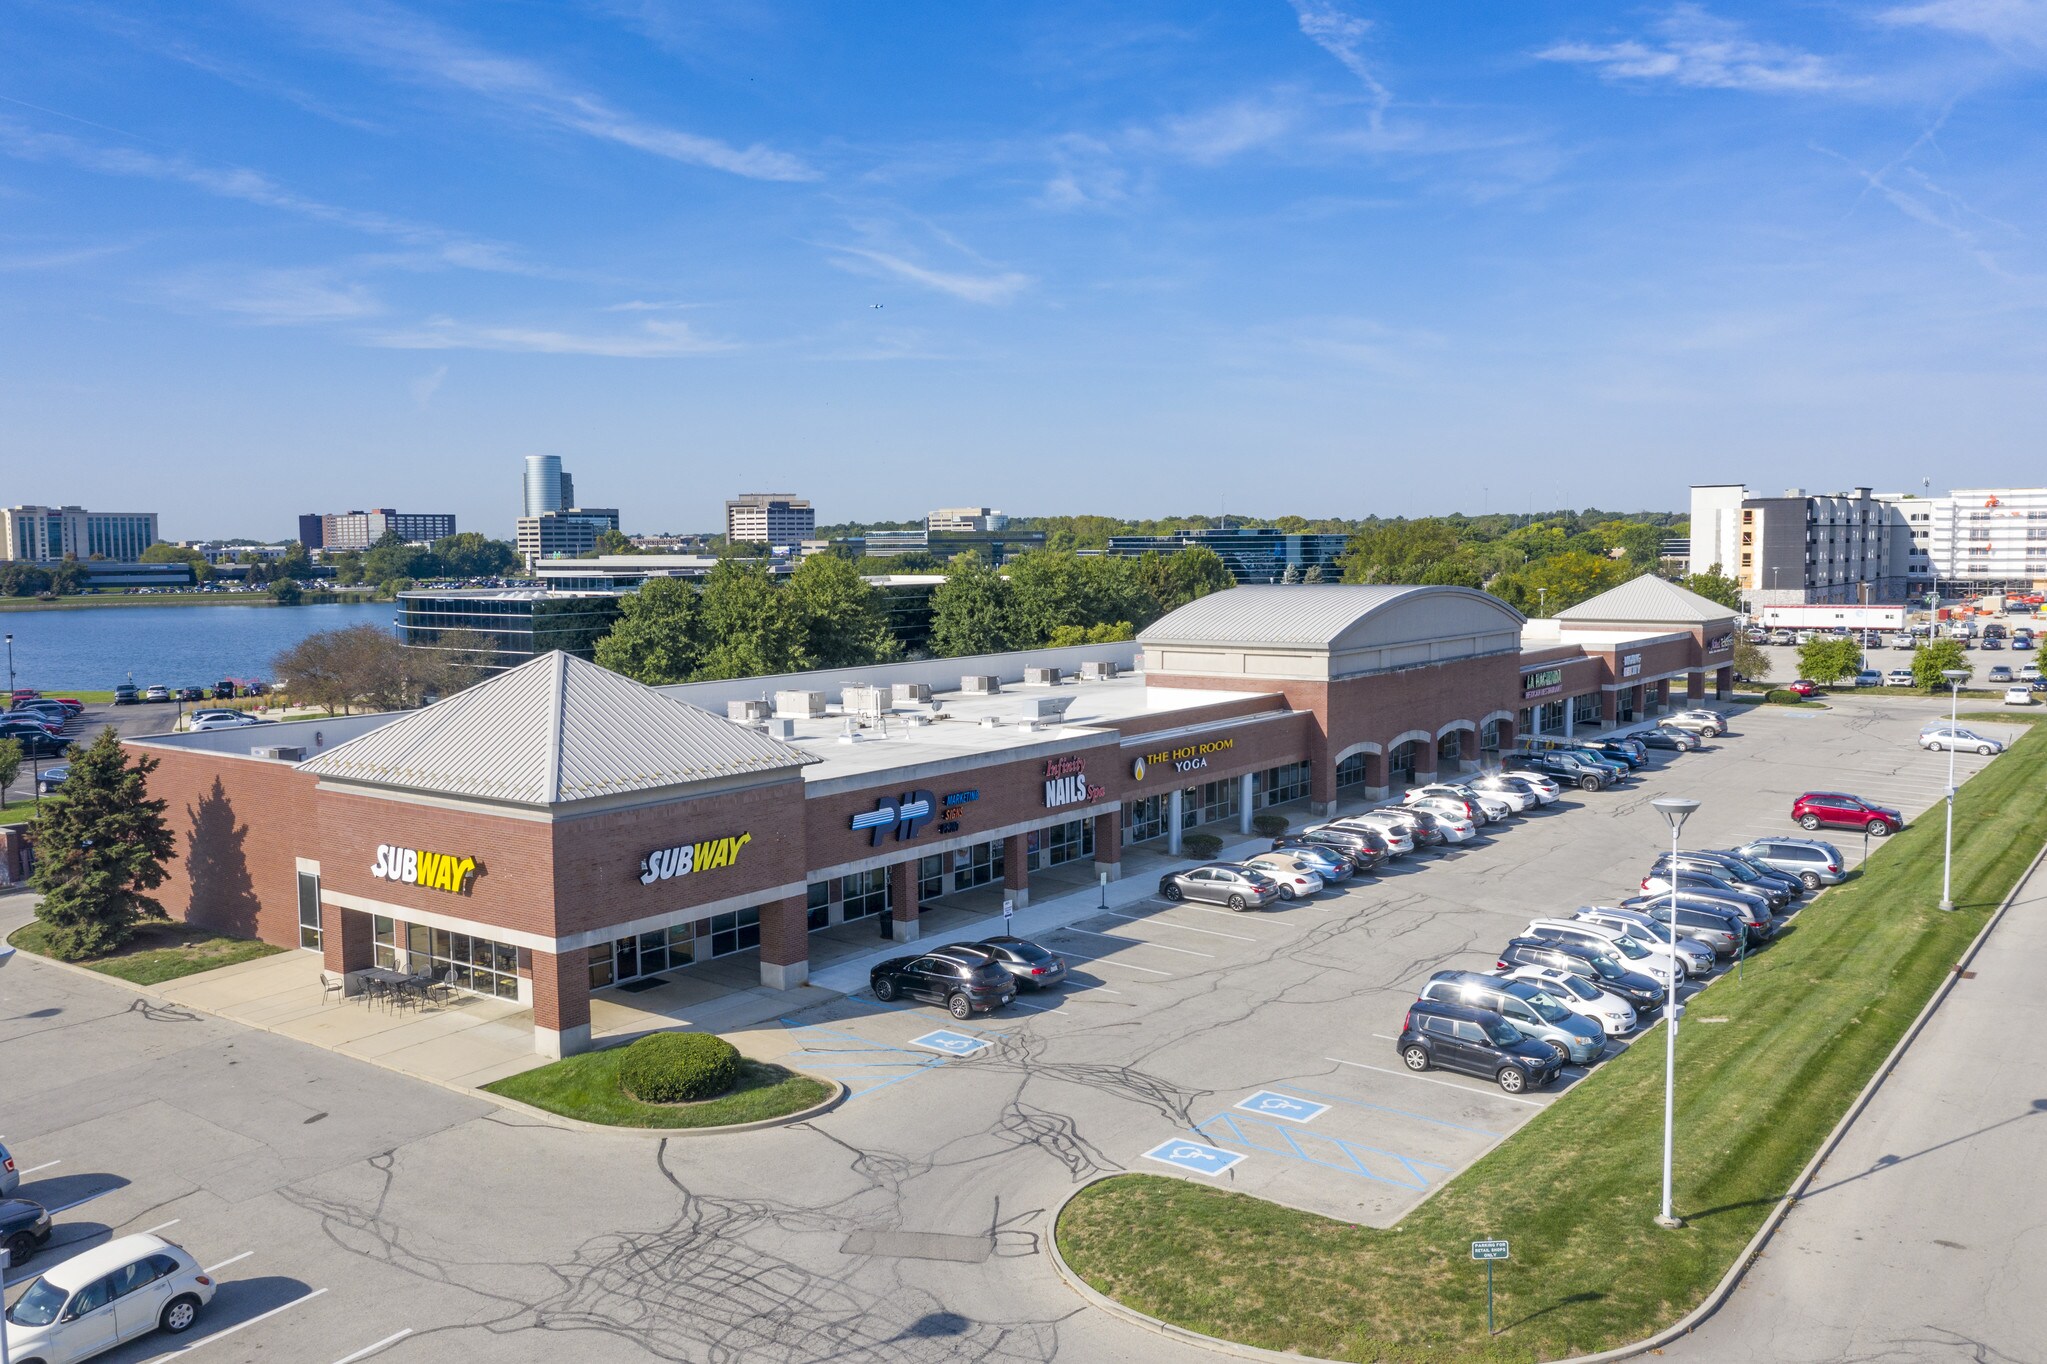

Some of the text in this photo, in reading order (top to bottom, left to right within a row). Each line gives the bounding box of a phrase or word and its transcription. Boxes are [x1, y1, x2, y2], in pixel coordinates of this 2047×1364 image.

[1147, 739, 1233, 765] THE HOT ROOM
[1175, 757, 1208, 773] YOGA
[946, 789, 980, 806] MARKETING
[1045, 773, 1087, 808] NAILS
[1087, 784, 1106, 803] Spa
[945, 806, 964, 820] SIGNS
[370, 844, 476, 892] SUBWAY
[640, 831, 752, 886] SUBWAY
